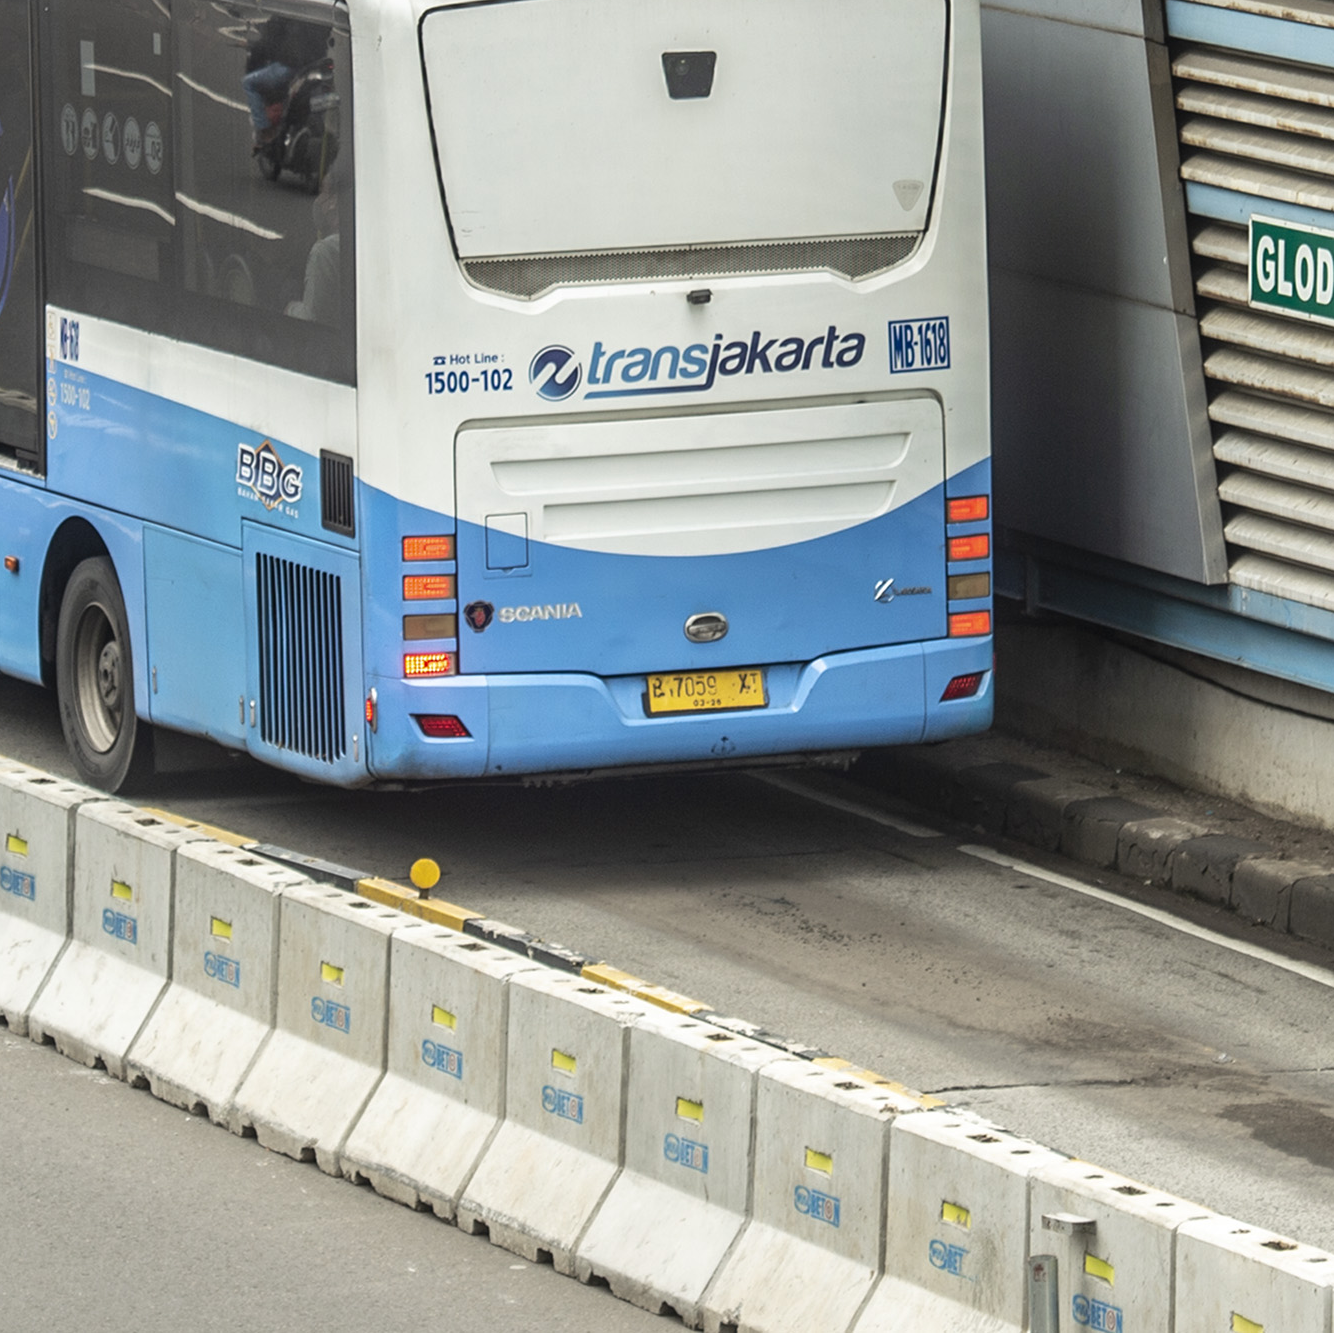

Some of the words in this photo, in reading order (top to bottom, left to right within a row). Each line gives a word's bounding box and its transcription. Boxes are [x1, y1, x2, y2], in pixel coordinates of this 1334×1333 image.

[450, 354, 470, 365] Hot
[584, 325, 866, 400] transjakarta
[893, 322, 946, 368] MB-1618
[425, 368, 513, 395] 1500-102
[236, 443, 303, 503] BBG
[498, 602, 583, 623] SCANIA
